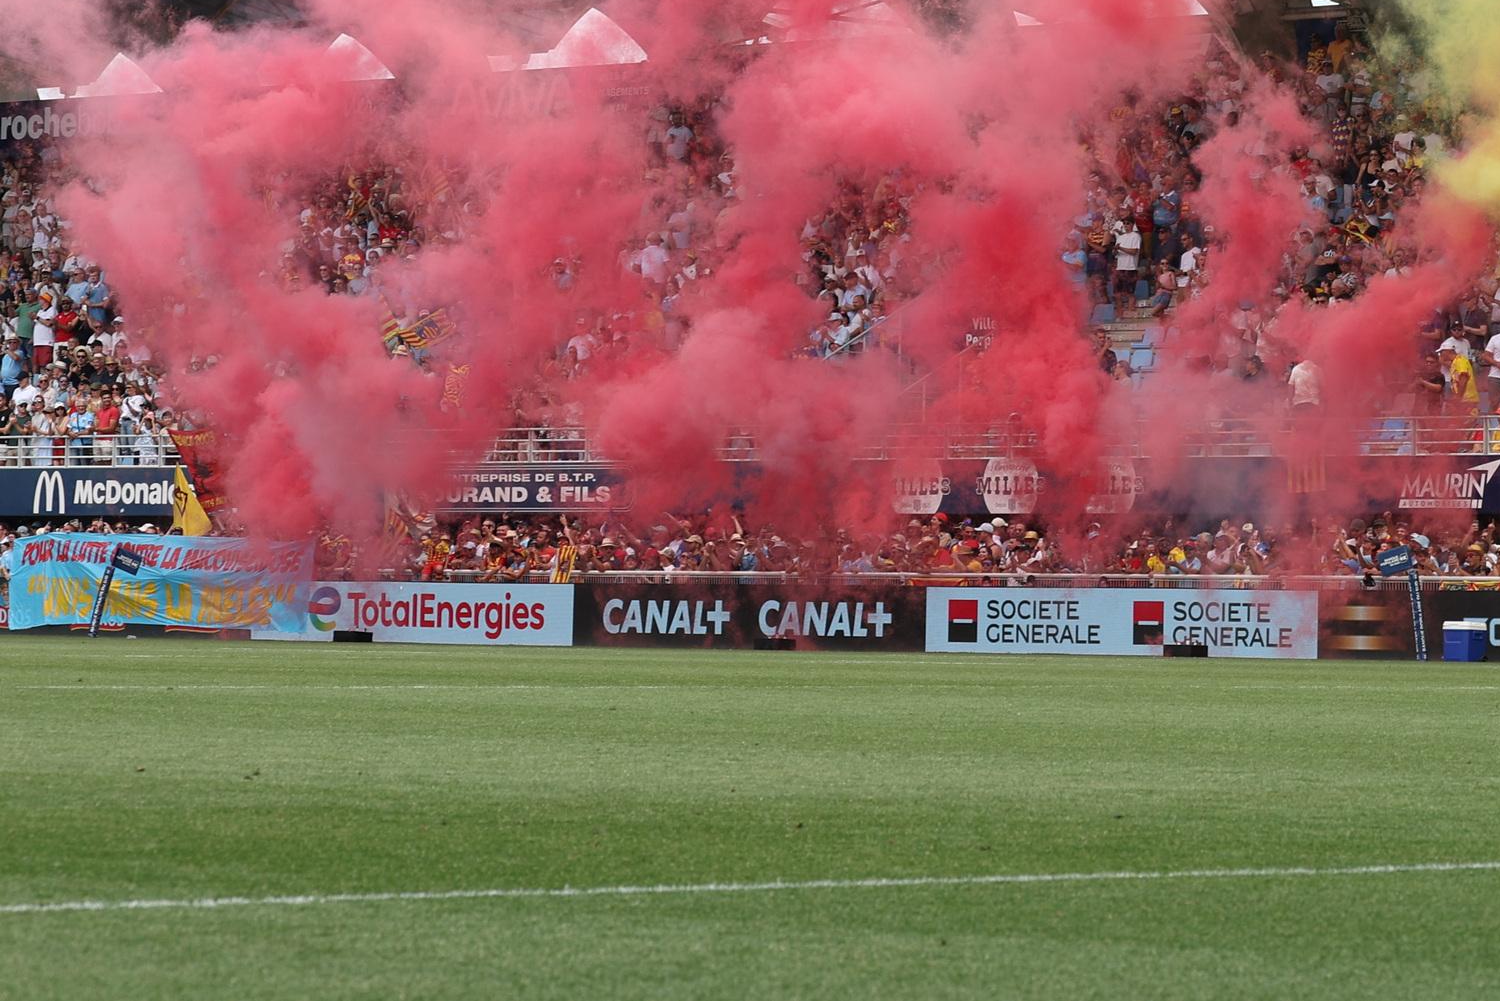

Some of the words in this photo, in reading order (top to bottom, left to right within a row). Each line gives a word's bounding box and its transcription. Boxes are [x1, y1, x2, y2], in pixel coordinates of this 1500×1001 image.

[450, 473, 531, 483] NTREPRISE
[535, 473, 554, 483] DE
[558, 472, 597, 482] B.T.P.
[894, 476, 951, 496] ILLES
[976, 475, 1046, 495] MILLES
[1400, 473, 1487, 498] MAURIN
[446, 486, 528, 503] URAND
[535, 486, 553, 503] &
[560, 485, 611, 503] FILS
[22, 539, 55, 566] POUR
[347, 591, 545, 640] TotalEnergies
[602, 598, 731, 635] CANAL+
[758, 599, 893, 638] CANAL+
[986, 599, 1080, 620] SOCIETE
[1173, 601, 1271, 623] SOCIETE
[985, 623, 1101, 645] GENERALE
[1172, 626, 1293, 648] GENERALE
